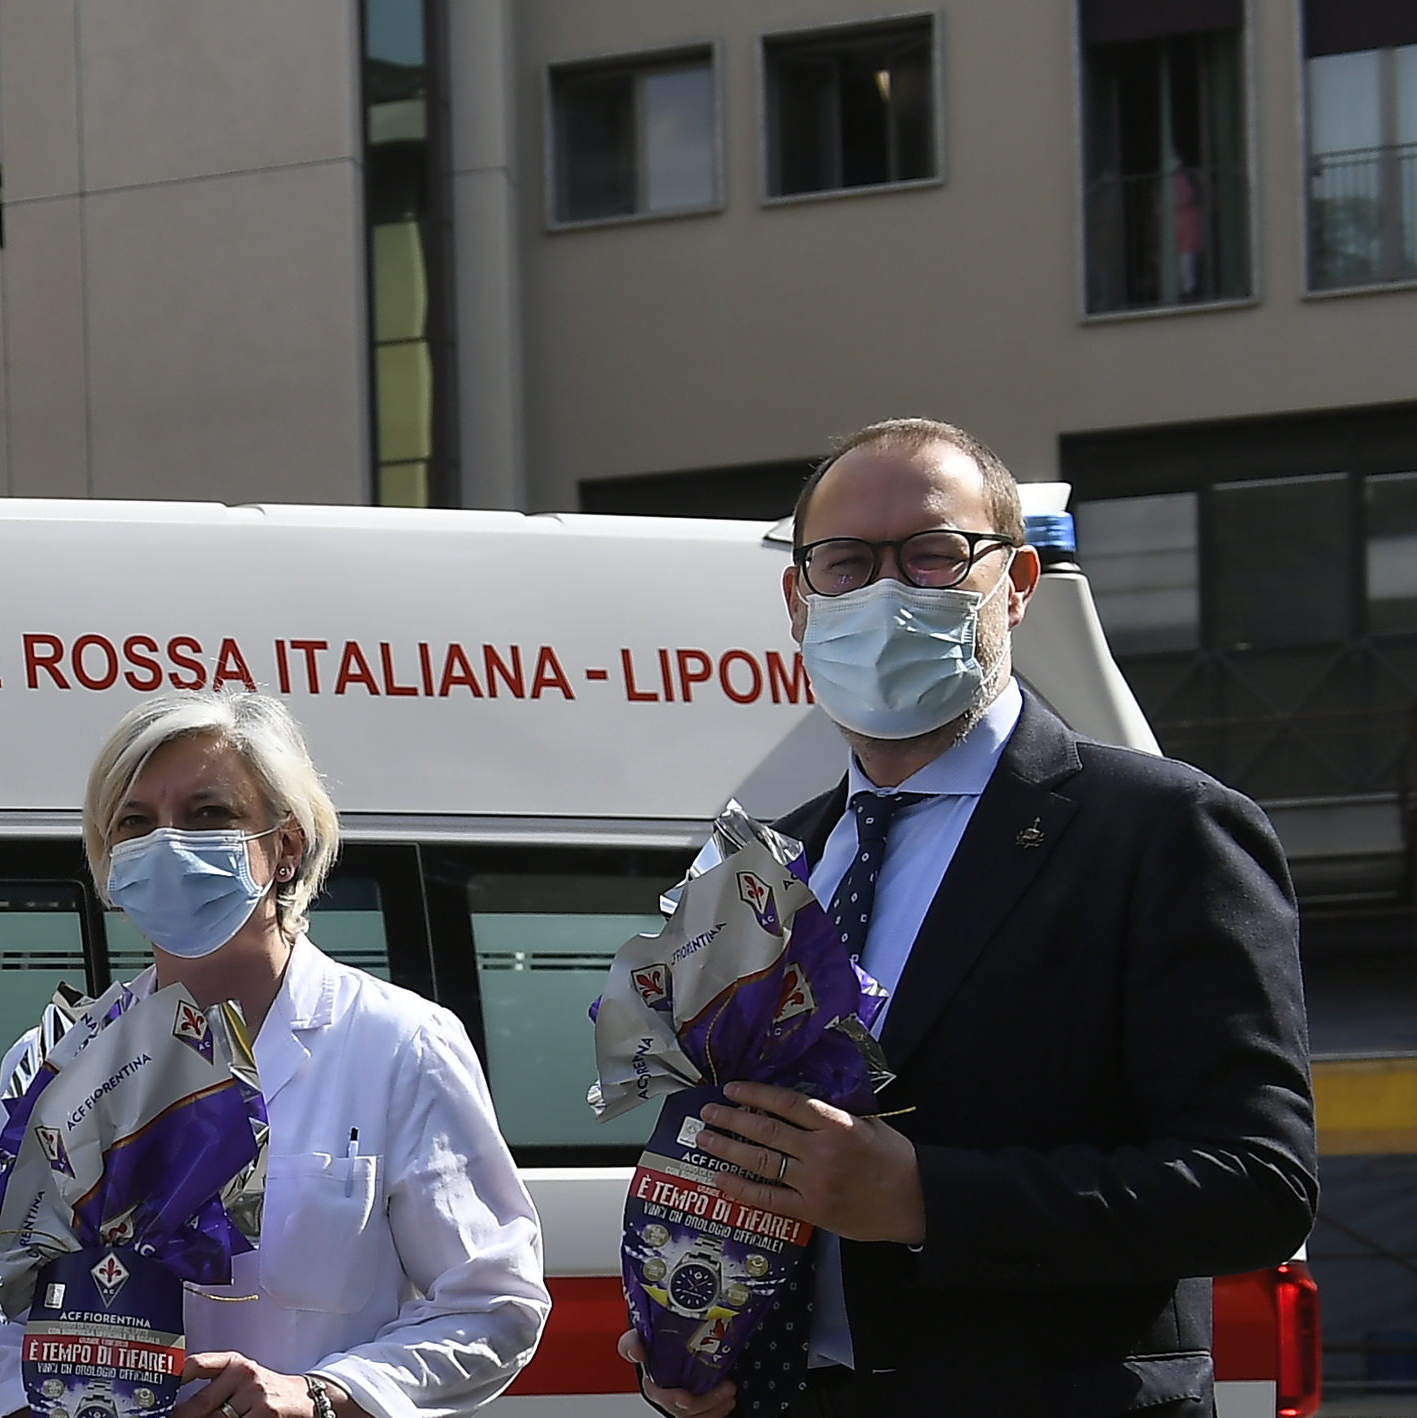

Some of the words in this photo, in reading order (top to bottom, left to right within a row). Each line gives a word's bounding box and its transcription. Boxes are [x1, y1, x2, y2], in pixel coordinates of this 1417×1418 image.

[22, 632, 259, 693] ROSSA
[274, 638, 576, 701] ITALIANA
[66, 1106, 86, 1132] ACF
[85, 1053, 152, 1111] FIORENTINA
[681, 1151, 708, 1167] ACF
[637, 1173, 652, 1199] È
[651, 1180, 709, 1216] TEMPO
[712, 1199, 733, 1223] DI
[736, 1205, 801, 1243] TIFARE!
[684, 1214, 732, 1239] OROLOGIO
[59, 1310, 81, 1321] ACF
[83, 1311, 152, 1329] FIORENTINA
[29, 1338, 39, 1361] È
[42, 1342, 91, 1364] TEMPO
[97, 1345, 113, 1366] DI
[118, 1348, 173, 1374] TIFARE!
[75, 1364, 116, 1378] OROLOGIO
